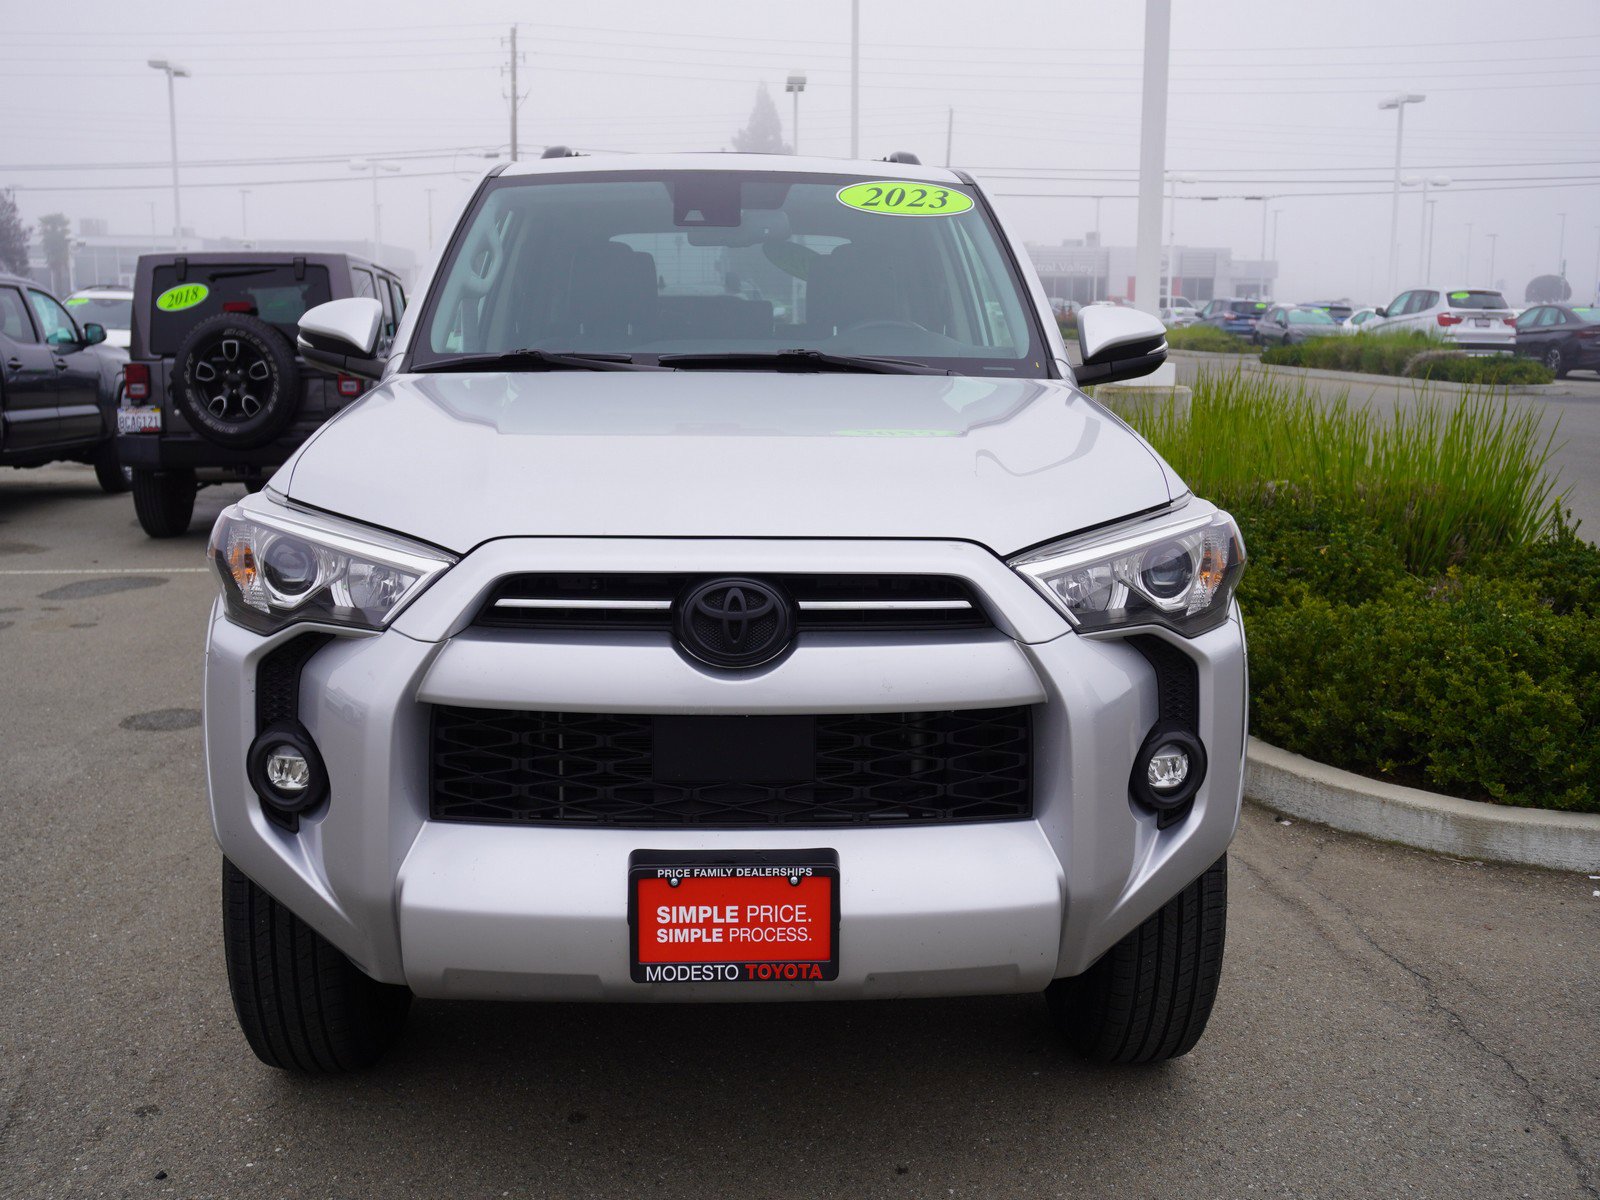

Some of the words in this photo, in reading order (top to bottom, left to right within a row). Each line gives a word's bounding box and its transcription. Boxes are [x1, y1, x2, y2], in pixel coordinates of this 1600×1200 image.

[860, 187, 949, 209] 2023
[1058, 261, 1095, 275] Valley
[166, 286, 199, 309] 2018
[657, 868, 691, 878] PRICE
[693, 868, 733, 877] FAMILY
[736, 867, 813, 877] DEALERSHIPS
[656, 905, 739, 924] SIMPLE
[746, 904, 812, 923] PRICE.
[656, 928, 723, 943] SIMPLE
[729, 927, 812, 942] PROCESS.
[646, 964, 739, 982] MODESTO
[745, 963, 823, 980] TOYOTA
